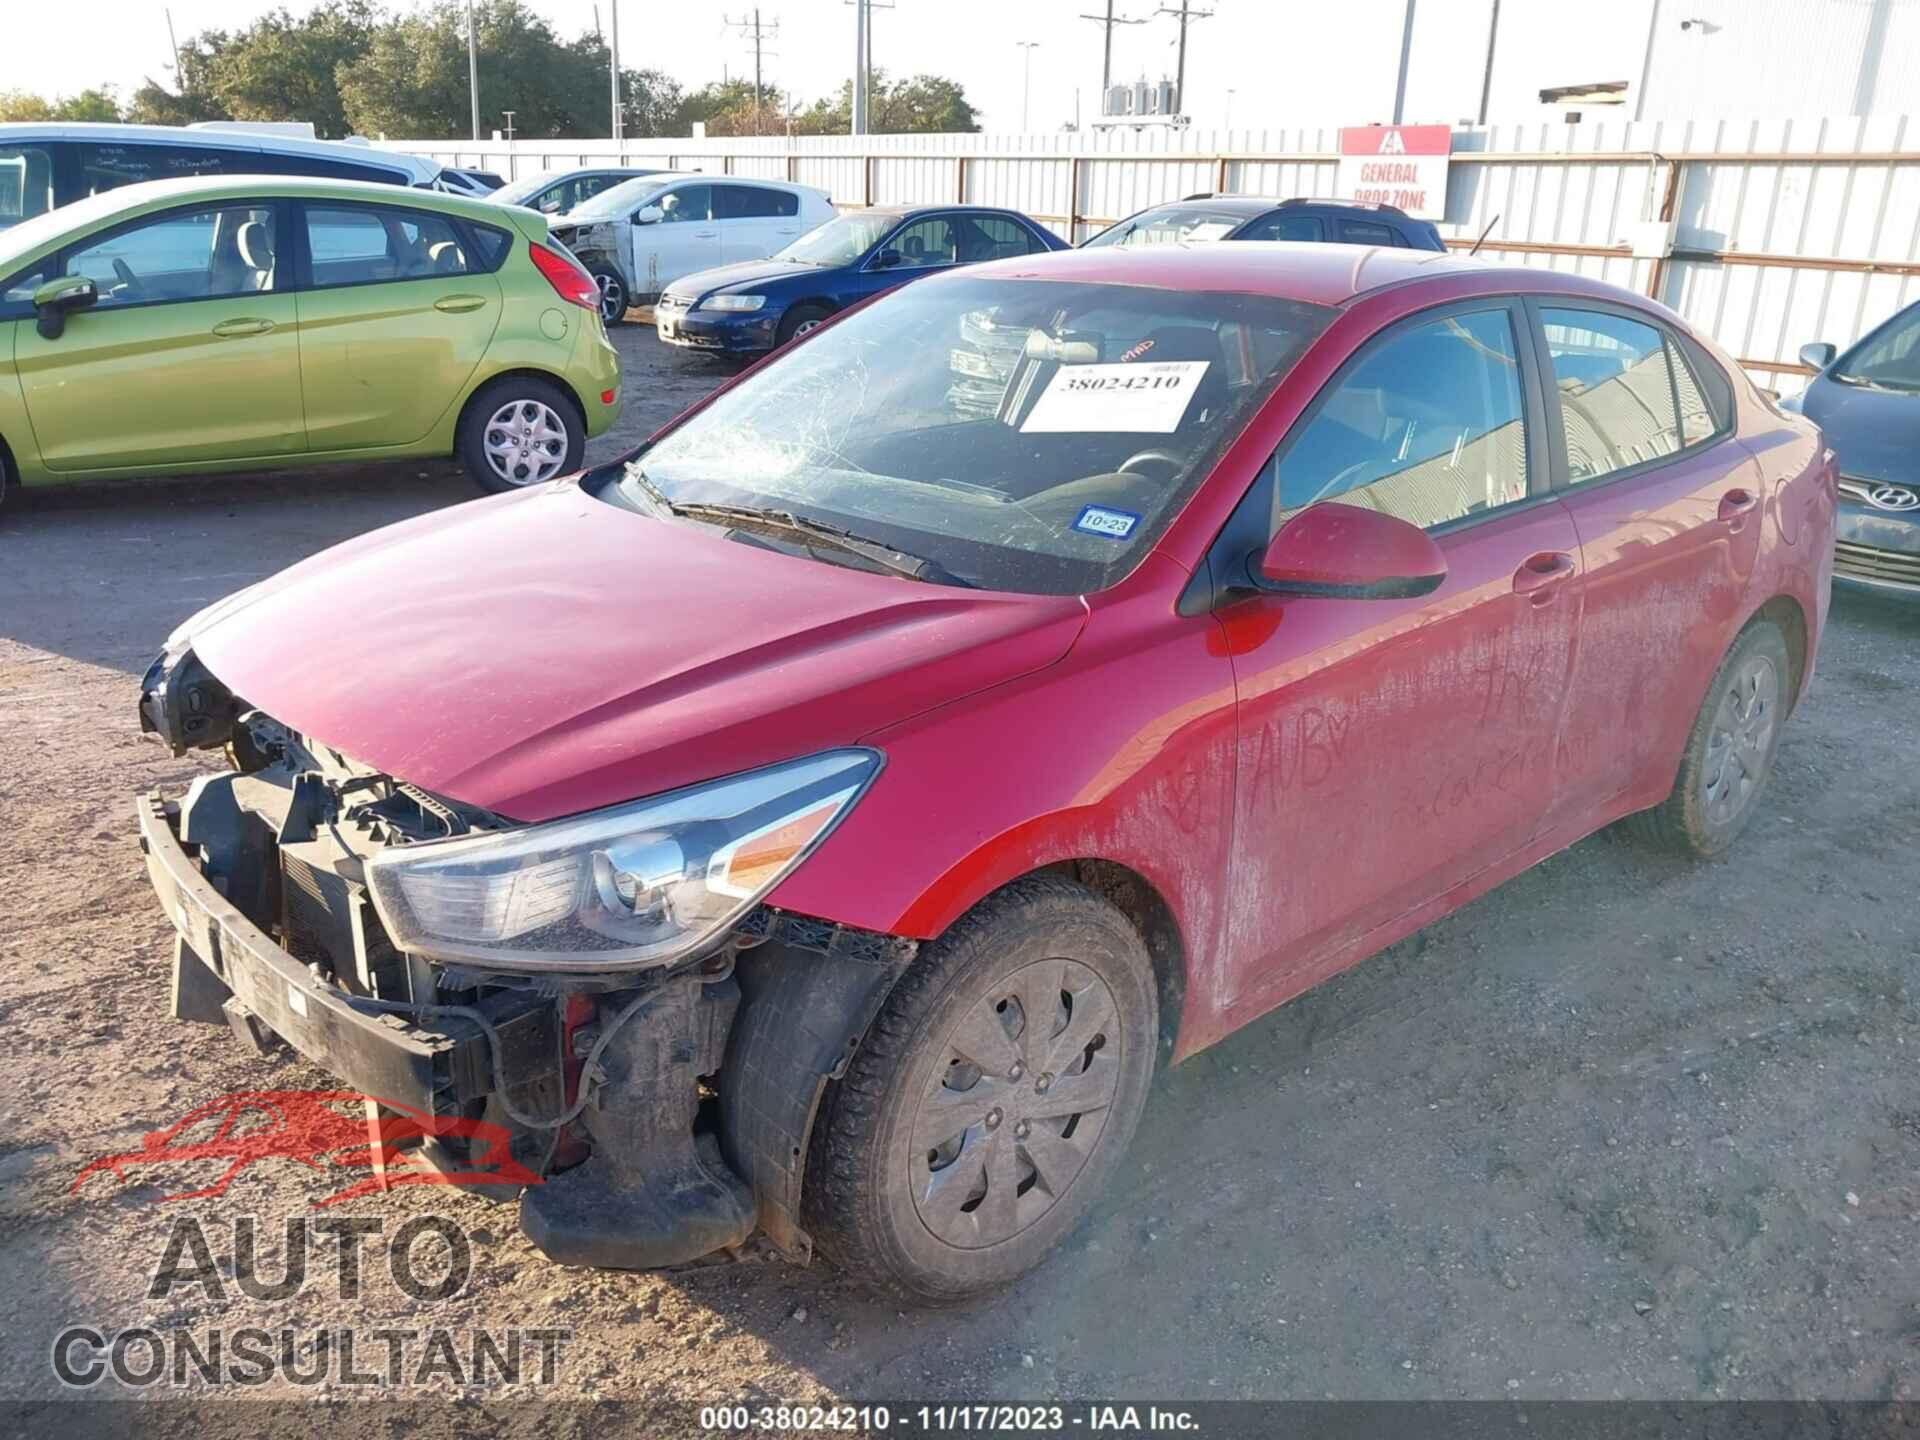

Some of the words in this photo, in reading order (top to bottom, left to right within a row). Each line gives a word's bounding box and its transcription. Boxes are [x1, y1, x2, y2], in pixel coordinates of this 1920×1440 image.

[1361, 163, 1418, 183] GENERAL
[1392, 188, 1426, 209] ZONE
[1060, 376, 1181, 391] 38024210
